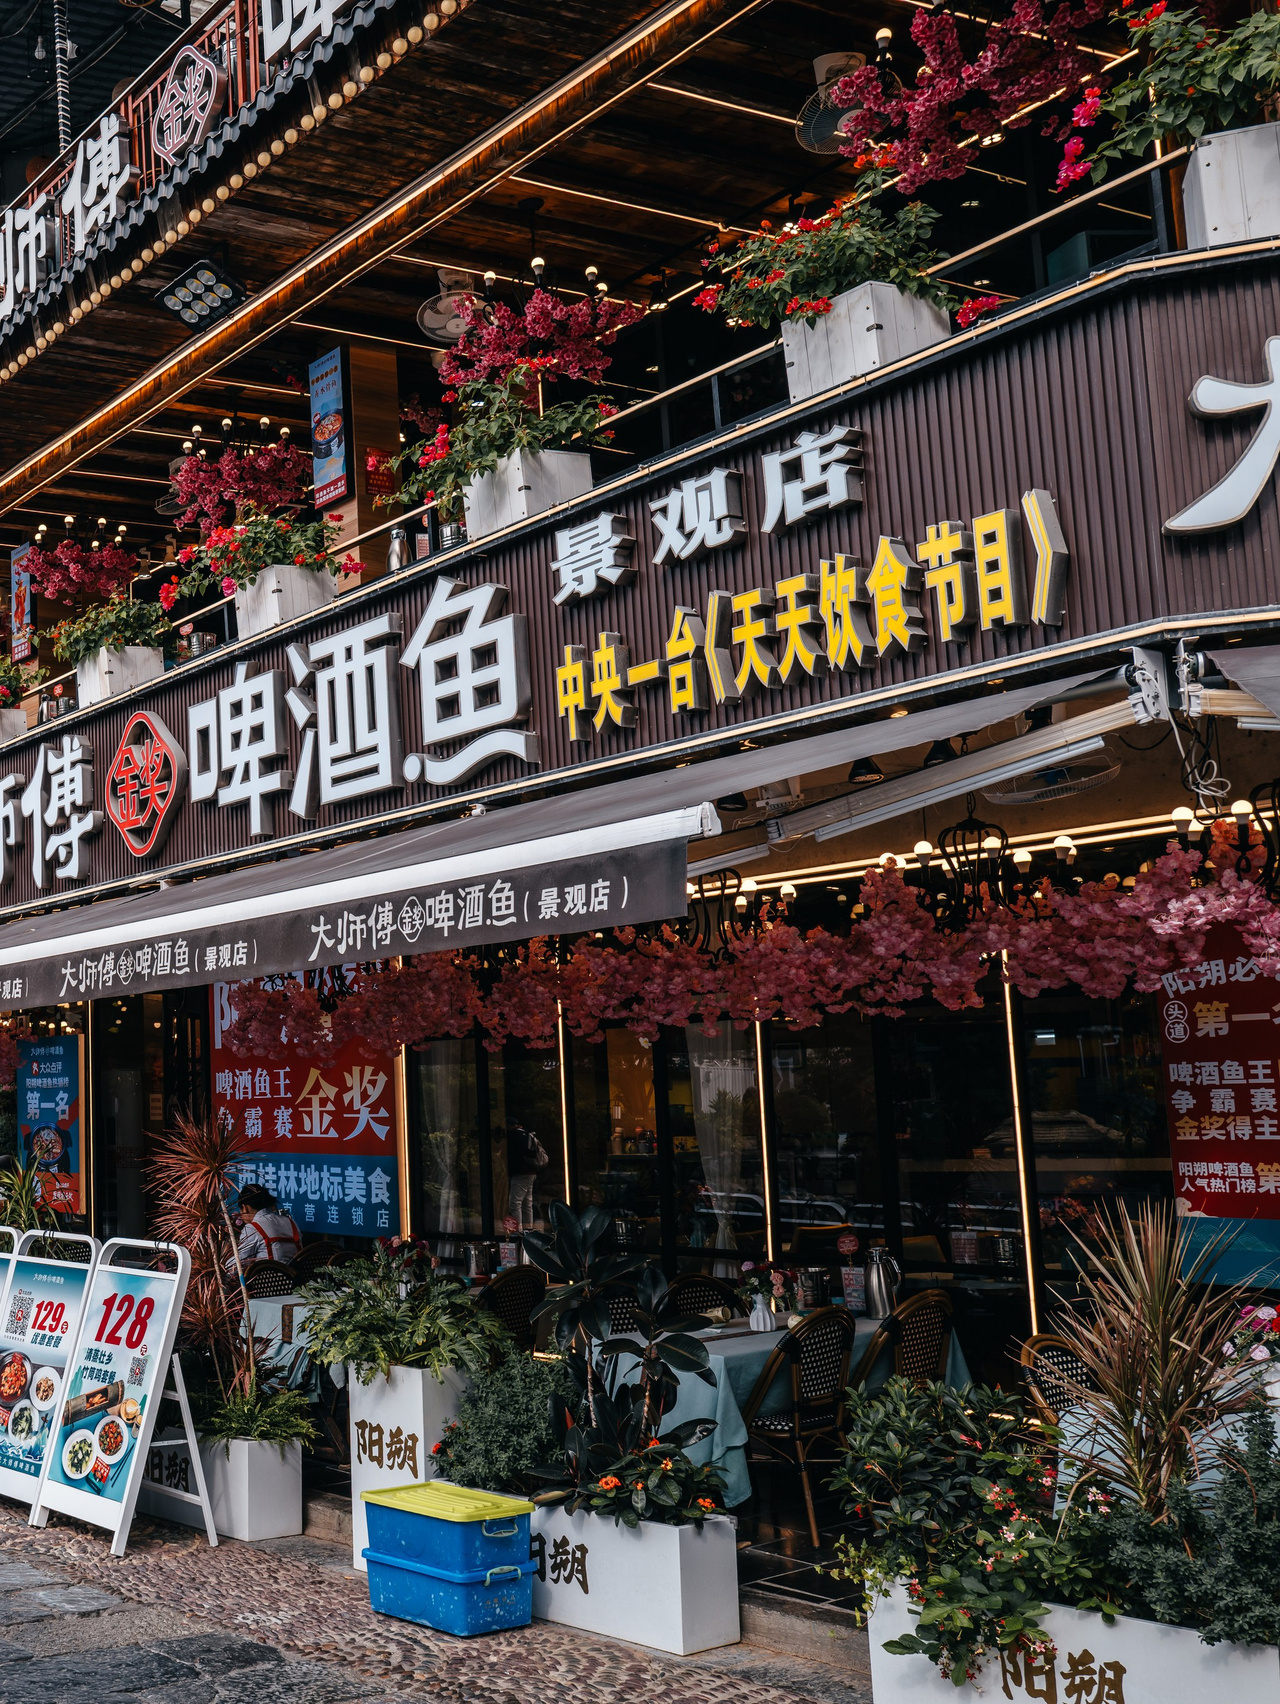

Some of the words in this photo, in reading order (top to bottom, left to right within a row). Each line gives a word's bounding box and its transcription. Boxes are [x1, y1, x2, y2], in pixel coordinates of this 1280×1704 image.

[550, 425, 858, 605] 景观店
[556, 489, 1058, 742] 中央一台《天天饮食节目》
[1161, 956, 1280, 998] 阳朔必
[40, 1062, 62, 1073] 大众点评
[216, 1066, 292, 1100] 啤酒鱼王
[1169, 1060, 1274, 1086] 啤酒鱼王
[26, 1090, 69, 1120] 第一名
[295, 1065, 391, 1141] 金奖
[1171, 1087, 1278, 1114] 争霸赛
[218, 1106, 293, 1139] 争霸赛
[1174, 1115, 1280, 1141] 金奖得主
[223, 1162, 391, 1205] 西桂林地标美食
[1178, 1161, 1255, 1177] 阳朔啤酒鱼
[1180, 1177, 1256, 1194] 人气热门榜
[31, 1300, 65, 1333] 129
[95, 1292, 155, 1349] 128
[31, 1332, 62, 1348] 优惠套餐
[355, 1418, 418, 1480] 阳朔
